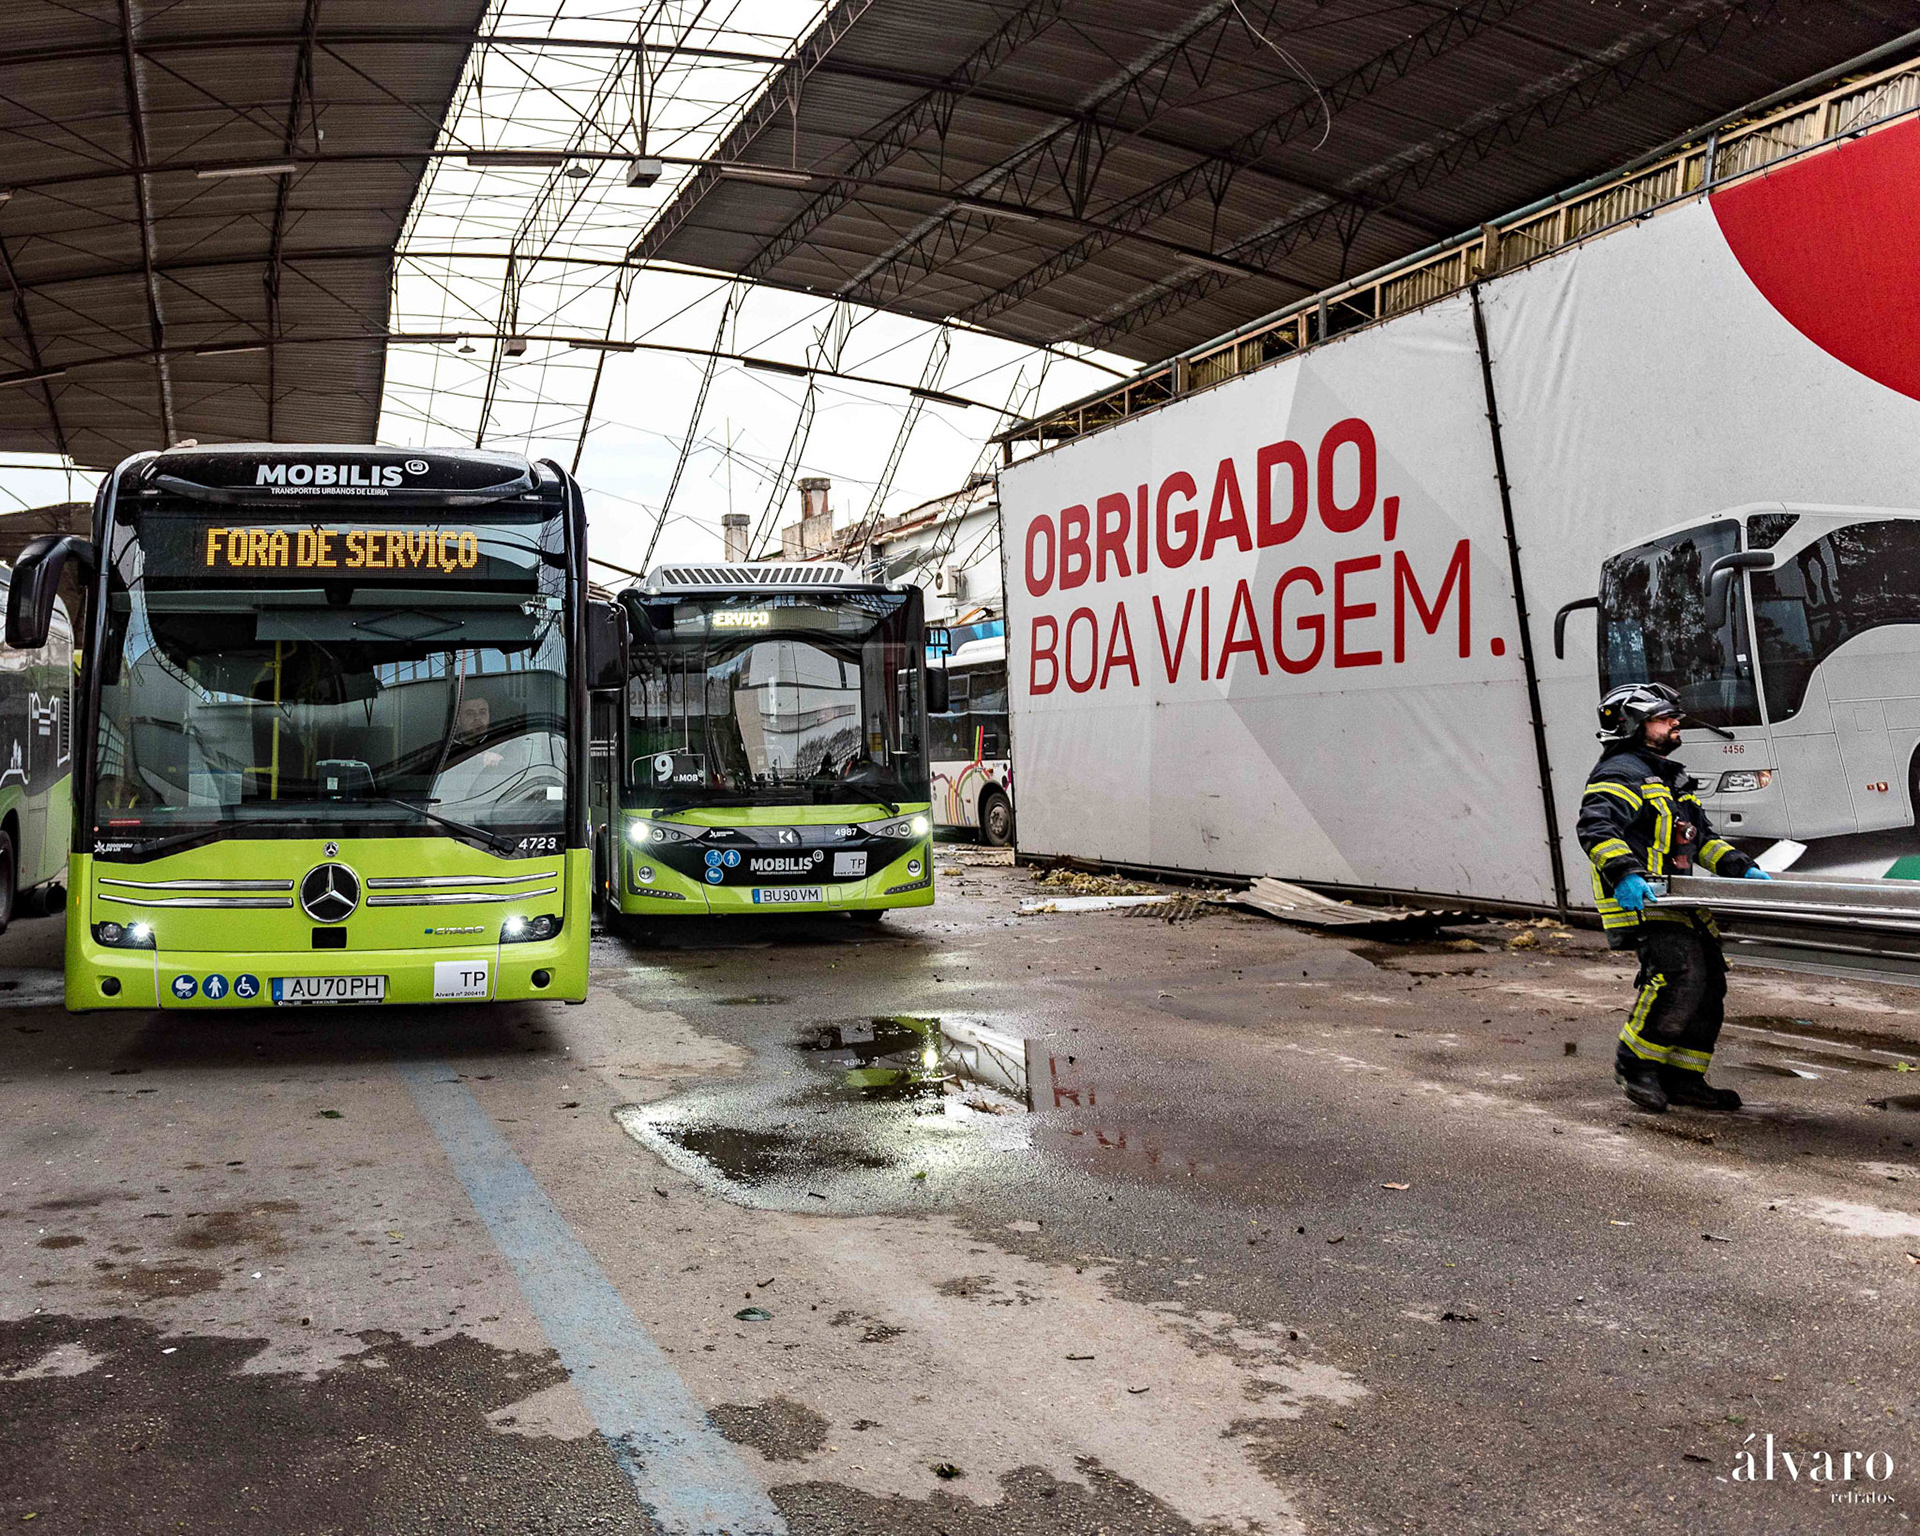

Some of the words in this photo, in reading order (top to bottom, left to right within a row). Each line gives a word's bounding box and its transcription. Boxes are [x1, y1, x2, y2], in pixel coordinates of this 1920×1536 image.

[255, 464, 403, 487] MOBILIS
[271, 487, 321, 495] TRANSPORTES
[366, 488, 389, 496] LEIRIA
[1025, 417, 1400, 598] OBRIGADO,
[206, 528, 289, 566] FORA
[296, 530, 338, 567] DE
[345, 530, 478, 573] SERVIÇO
[1029, 600, 1140, 696] BOA
[1152, 538, 1506, 684] VIAGEM.
[1722, 745, 1745, 754] 4456
[654, 754, 674, 781] 9
[834, 827, 857, 836] 4987
[518, 837, 557, 850] 4723
[750, 857, 813, 871] MOBILIS
[850, 858, 866, 869] TP
[460, 971, 486, 987] TP
